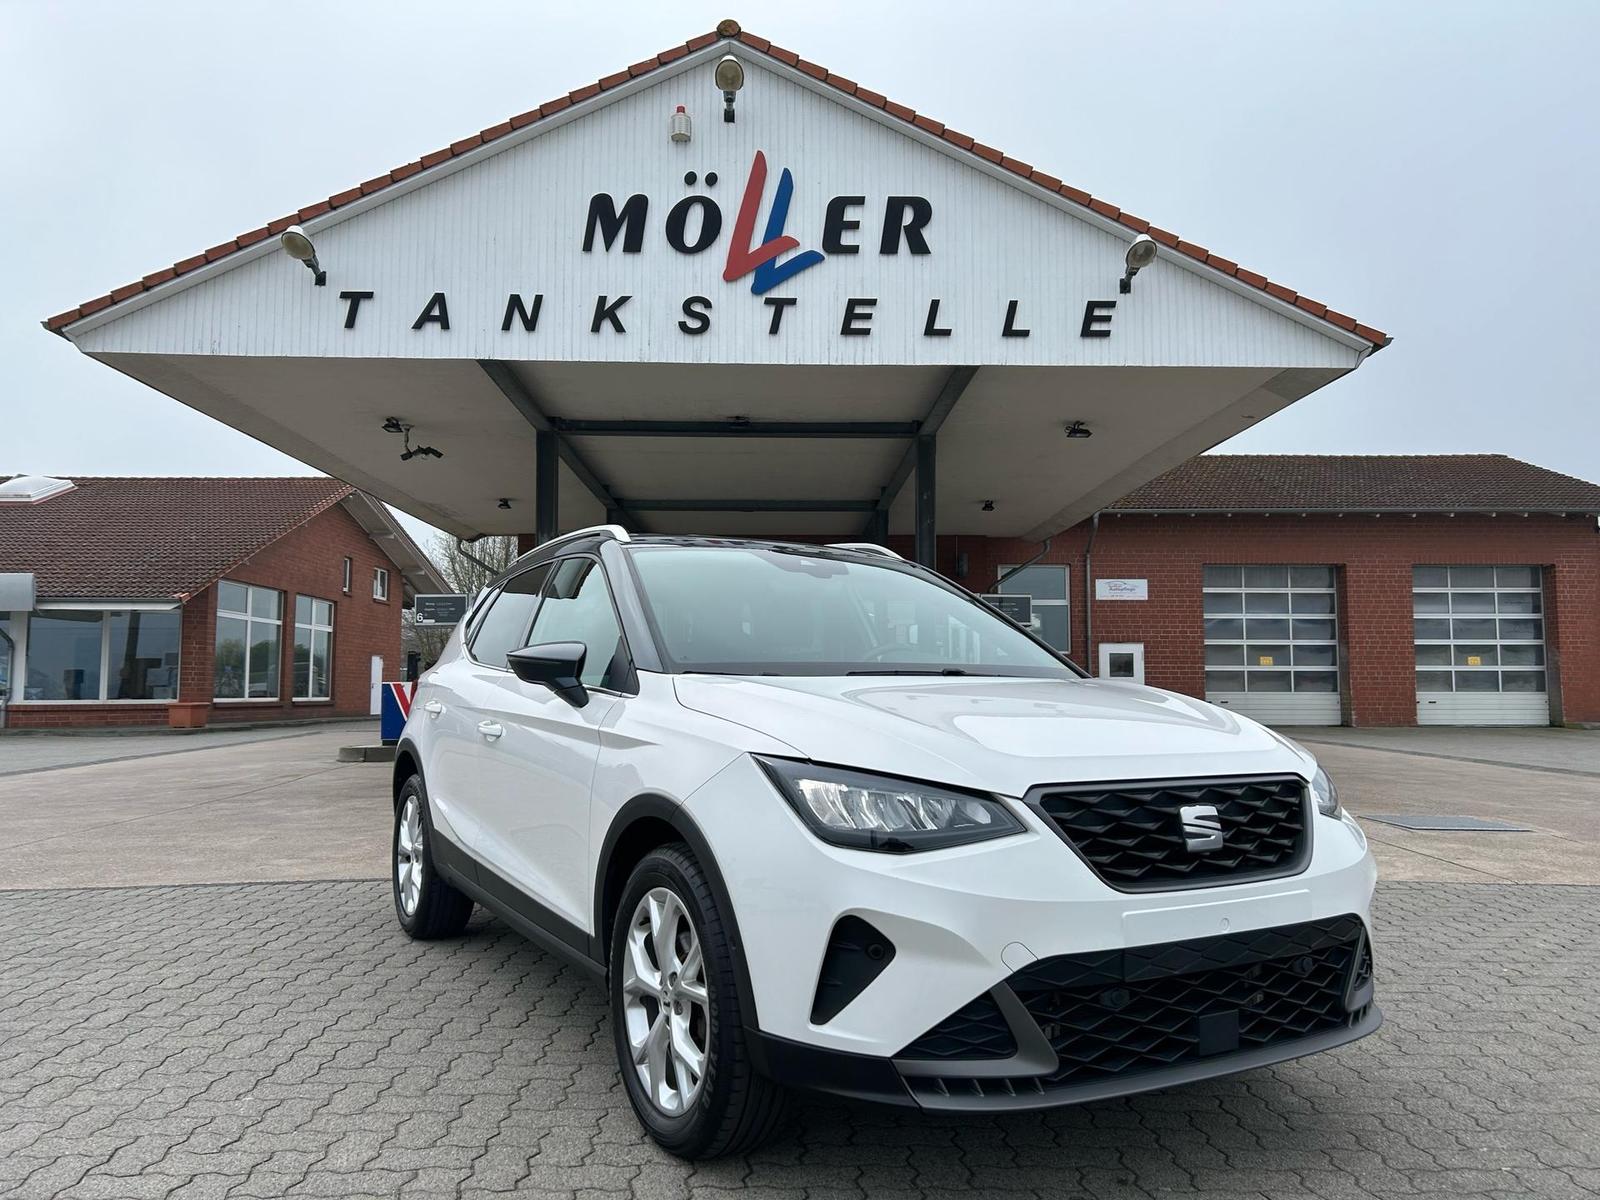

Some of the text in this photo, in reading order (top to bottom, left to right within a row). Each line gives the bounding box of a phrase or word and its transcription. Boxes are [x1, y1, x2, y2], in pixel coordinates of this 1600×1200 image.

[582, 150, 933, 296] MÖLLER
[339, 290, 1117, 338] TANKSTELLE
[416, 612, 424, 622] 6
